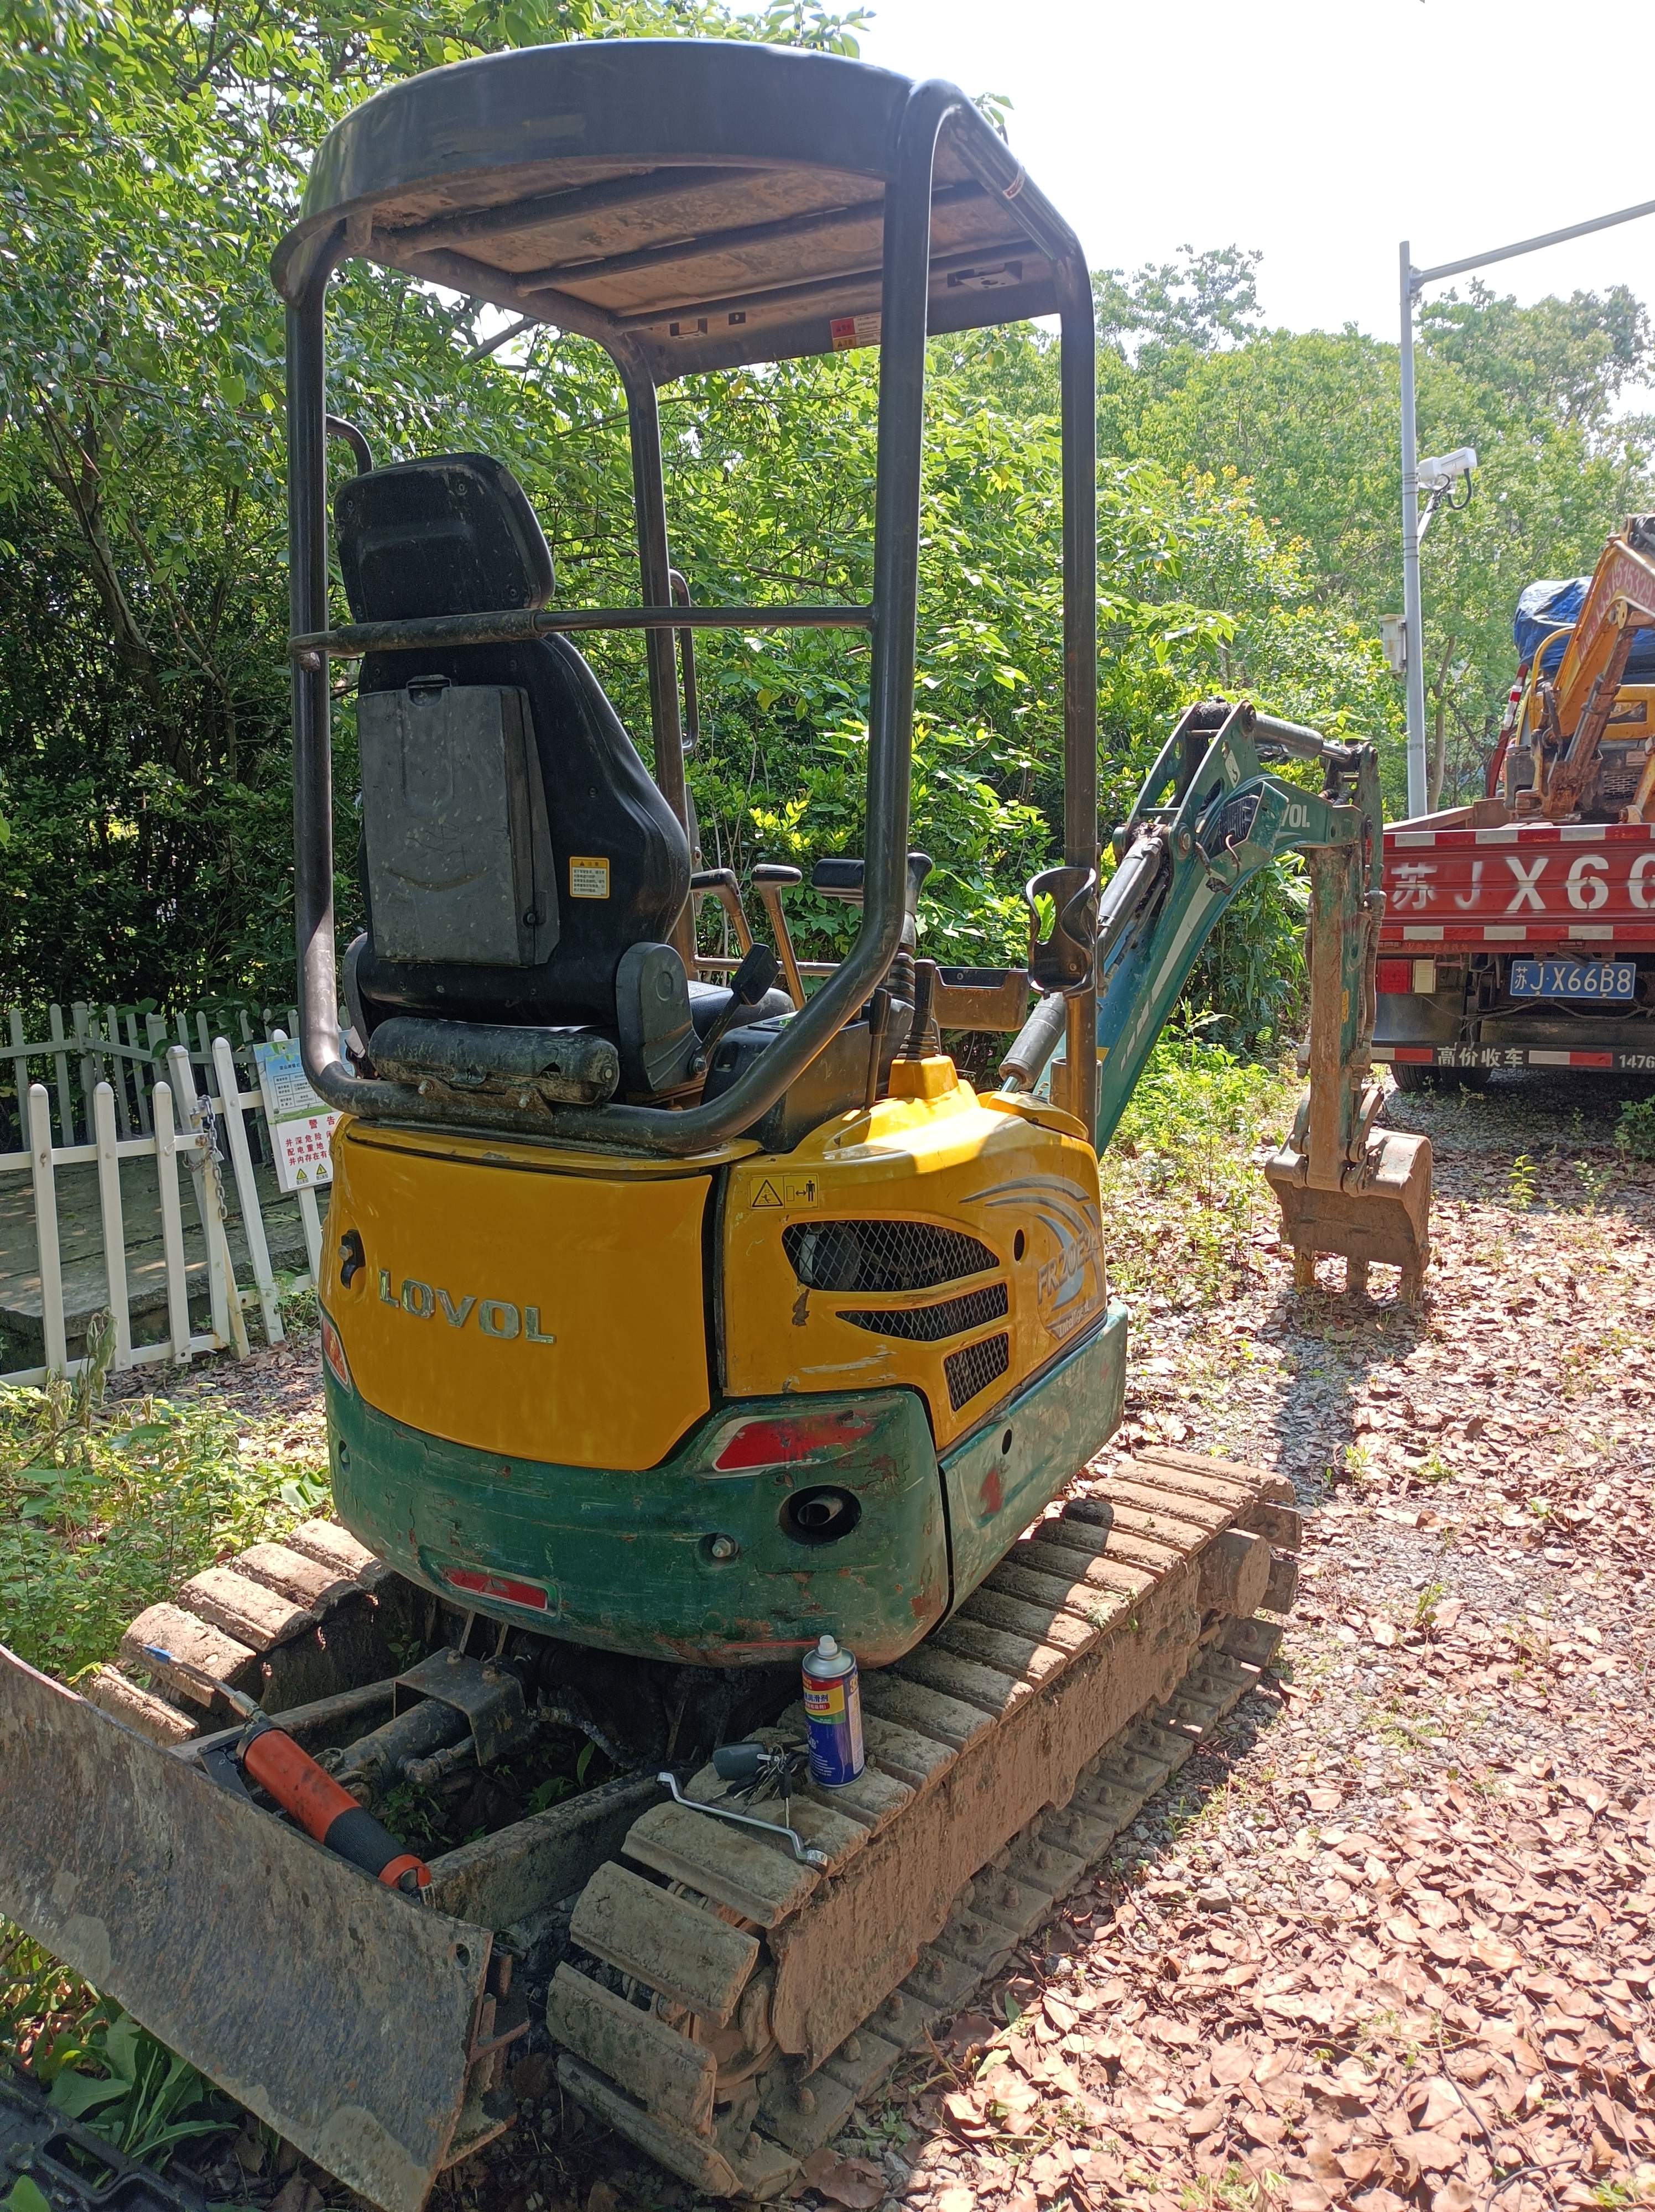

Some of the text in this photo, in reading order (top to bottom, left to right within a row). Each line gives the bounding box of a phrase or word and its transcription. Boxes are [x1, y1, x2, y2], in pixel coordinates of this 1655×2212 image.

[1437, 1046, 1523, 1068] 高价收车
[309, 1116, 335, 1129] 警告
[287, 1142, 324, 1156] 配电重地
[379, 1269, 556, 1344] LOVOL
